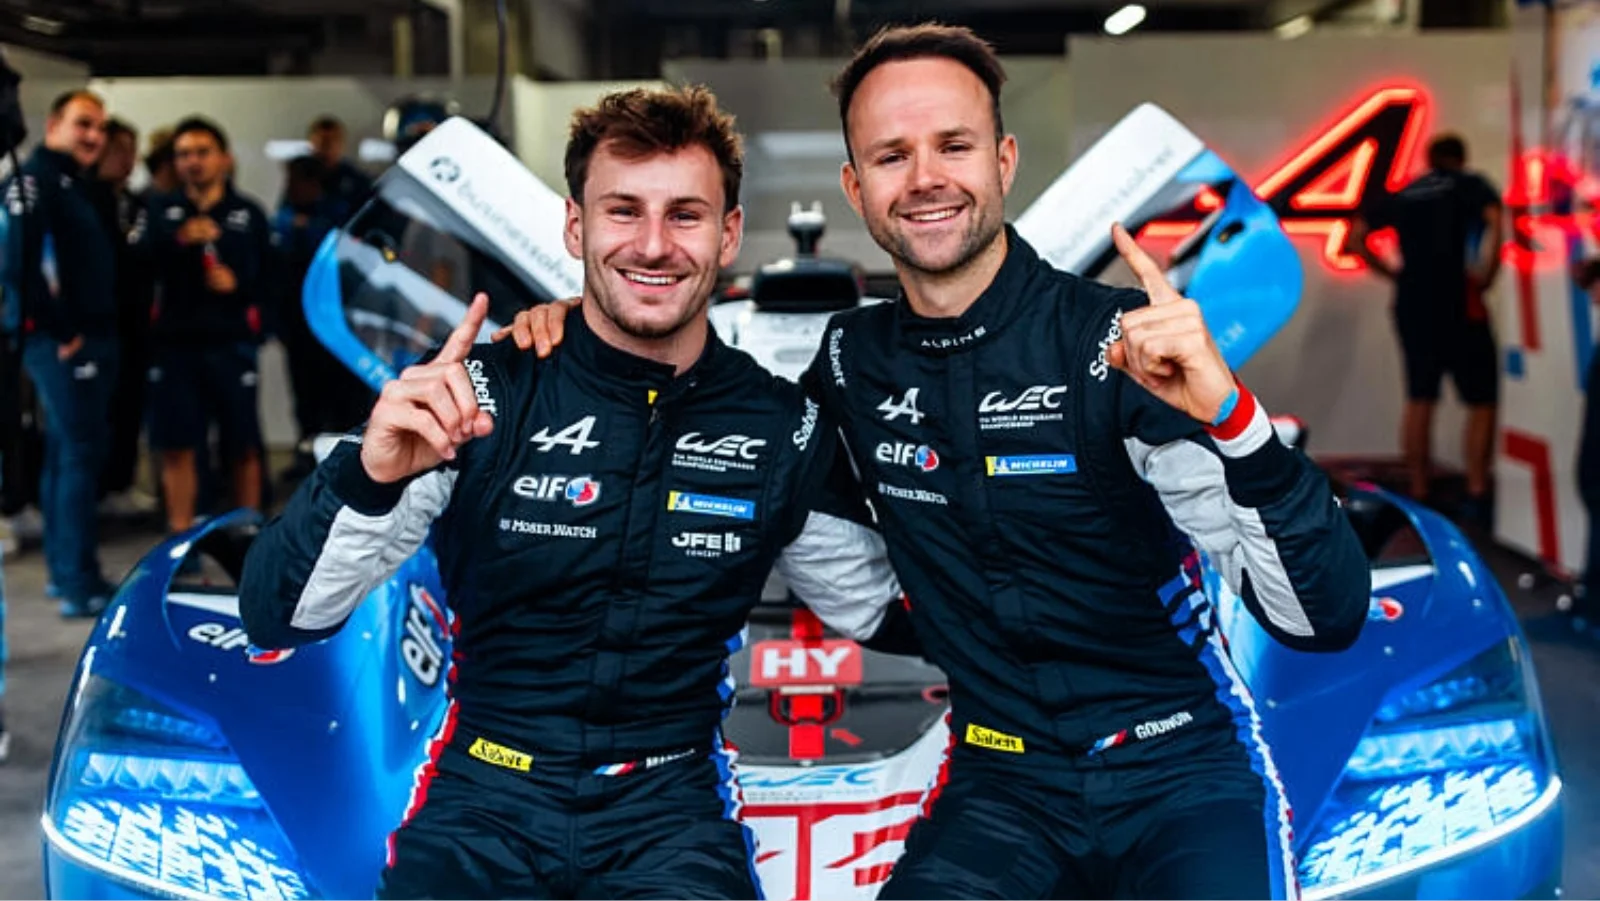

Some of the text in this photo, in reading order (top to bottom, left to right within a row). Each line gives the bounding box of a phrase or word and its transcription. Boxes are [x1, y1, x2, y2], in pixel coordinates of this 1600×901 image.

[921, 325, 987, 349] ALPINE
[978, 385, 1068, 412] WEC
[675, 431, 767, 459] WEC
[1010, 460, 1068, 470] MICHELIN
[672, 532, 722, 549] JFE
[761, 647, 850, 679] HY
[1134, 711, 1193, 740] GOUNON
[737, 764, 886, 788] WEC
